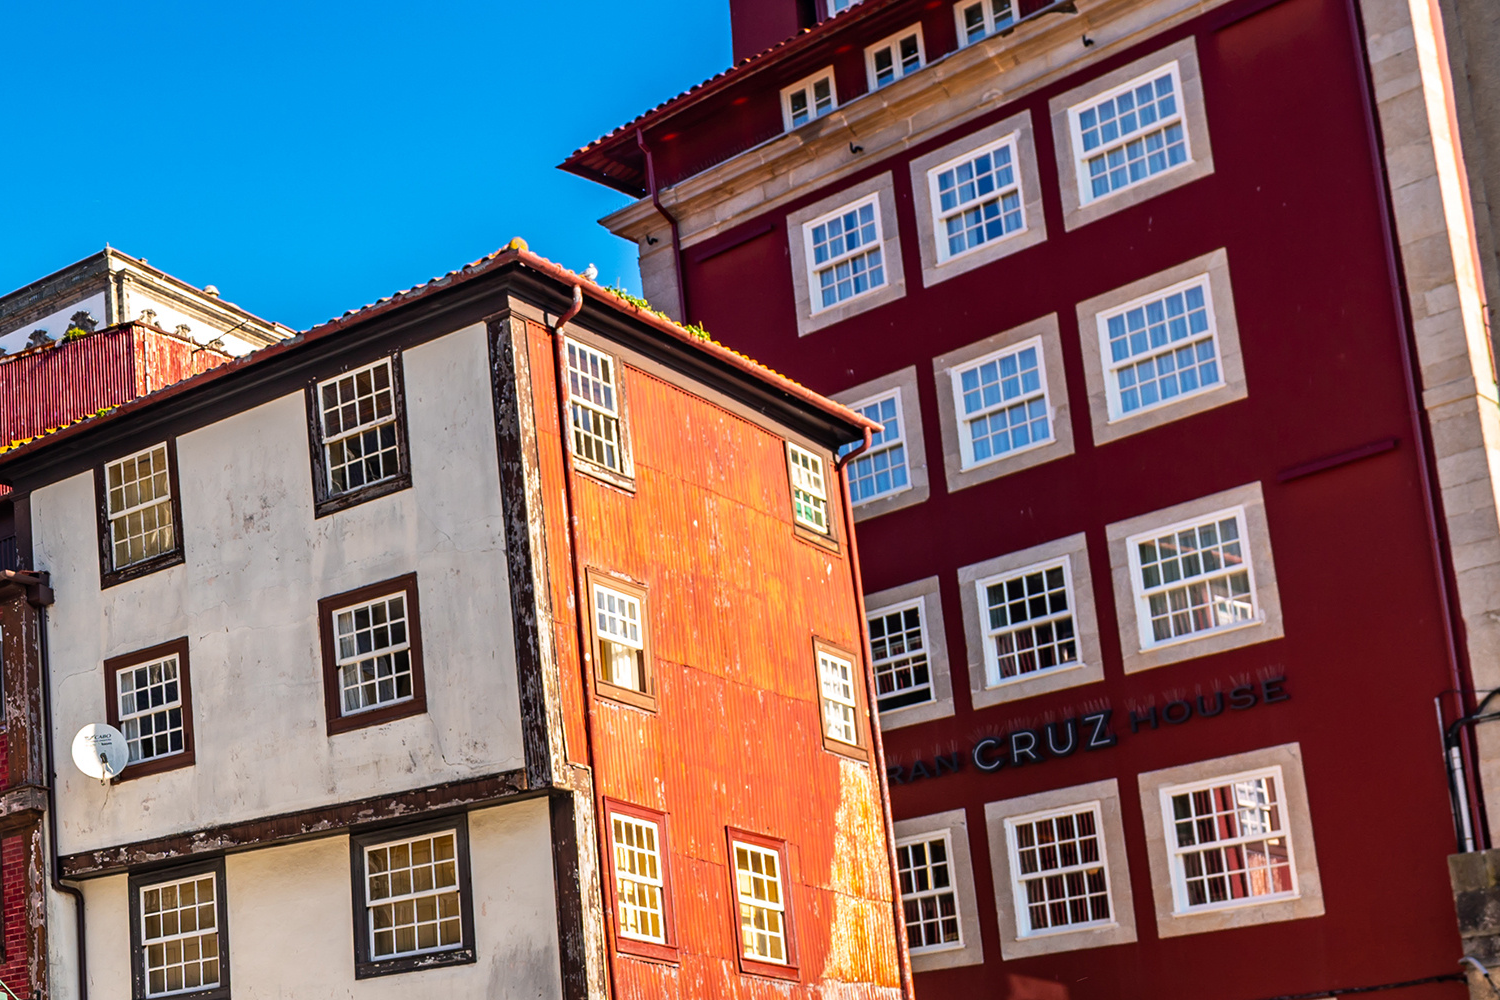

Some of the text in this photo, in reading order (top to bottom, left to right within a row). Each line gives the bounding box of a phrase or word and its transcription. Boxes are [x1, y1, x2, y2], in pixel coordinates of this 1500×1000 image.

[886, 676, 1291, 786] RAN CRUZ HOUSE
